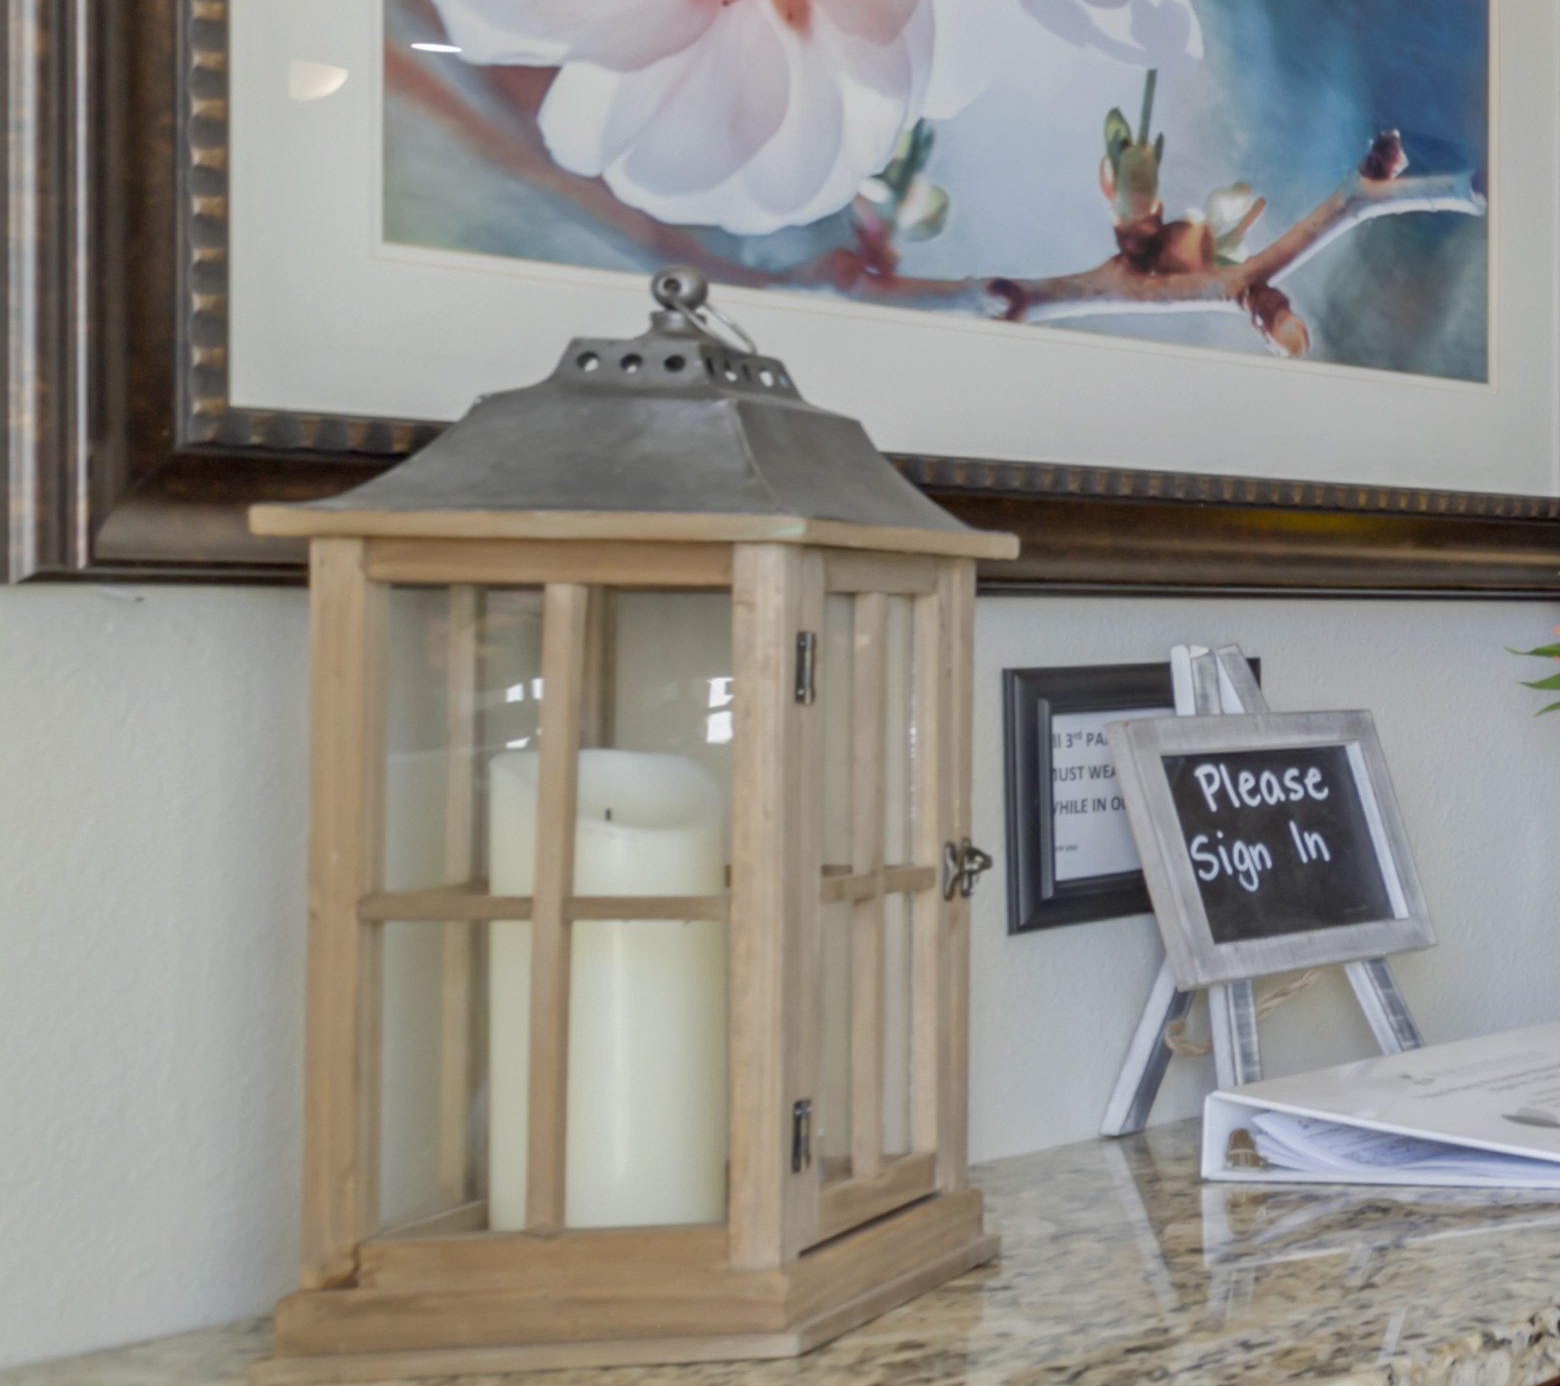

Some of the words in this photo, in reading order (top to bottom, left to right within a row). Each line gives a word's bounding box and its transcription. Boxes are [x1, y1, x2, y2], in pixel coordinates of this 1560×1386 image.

[1053, 799, 1087, 816] HILE
[1092, 797, 1107, 812] IN
[1194, 761, 1329, 812] Please
[1190, 831, 1273, 892] Sign
[1290, 820, 1330, 863] In
